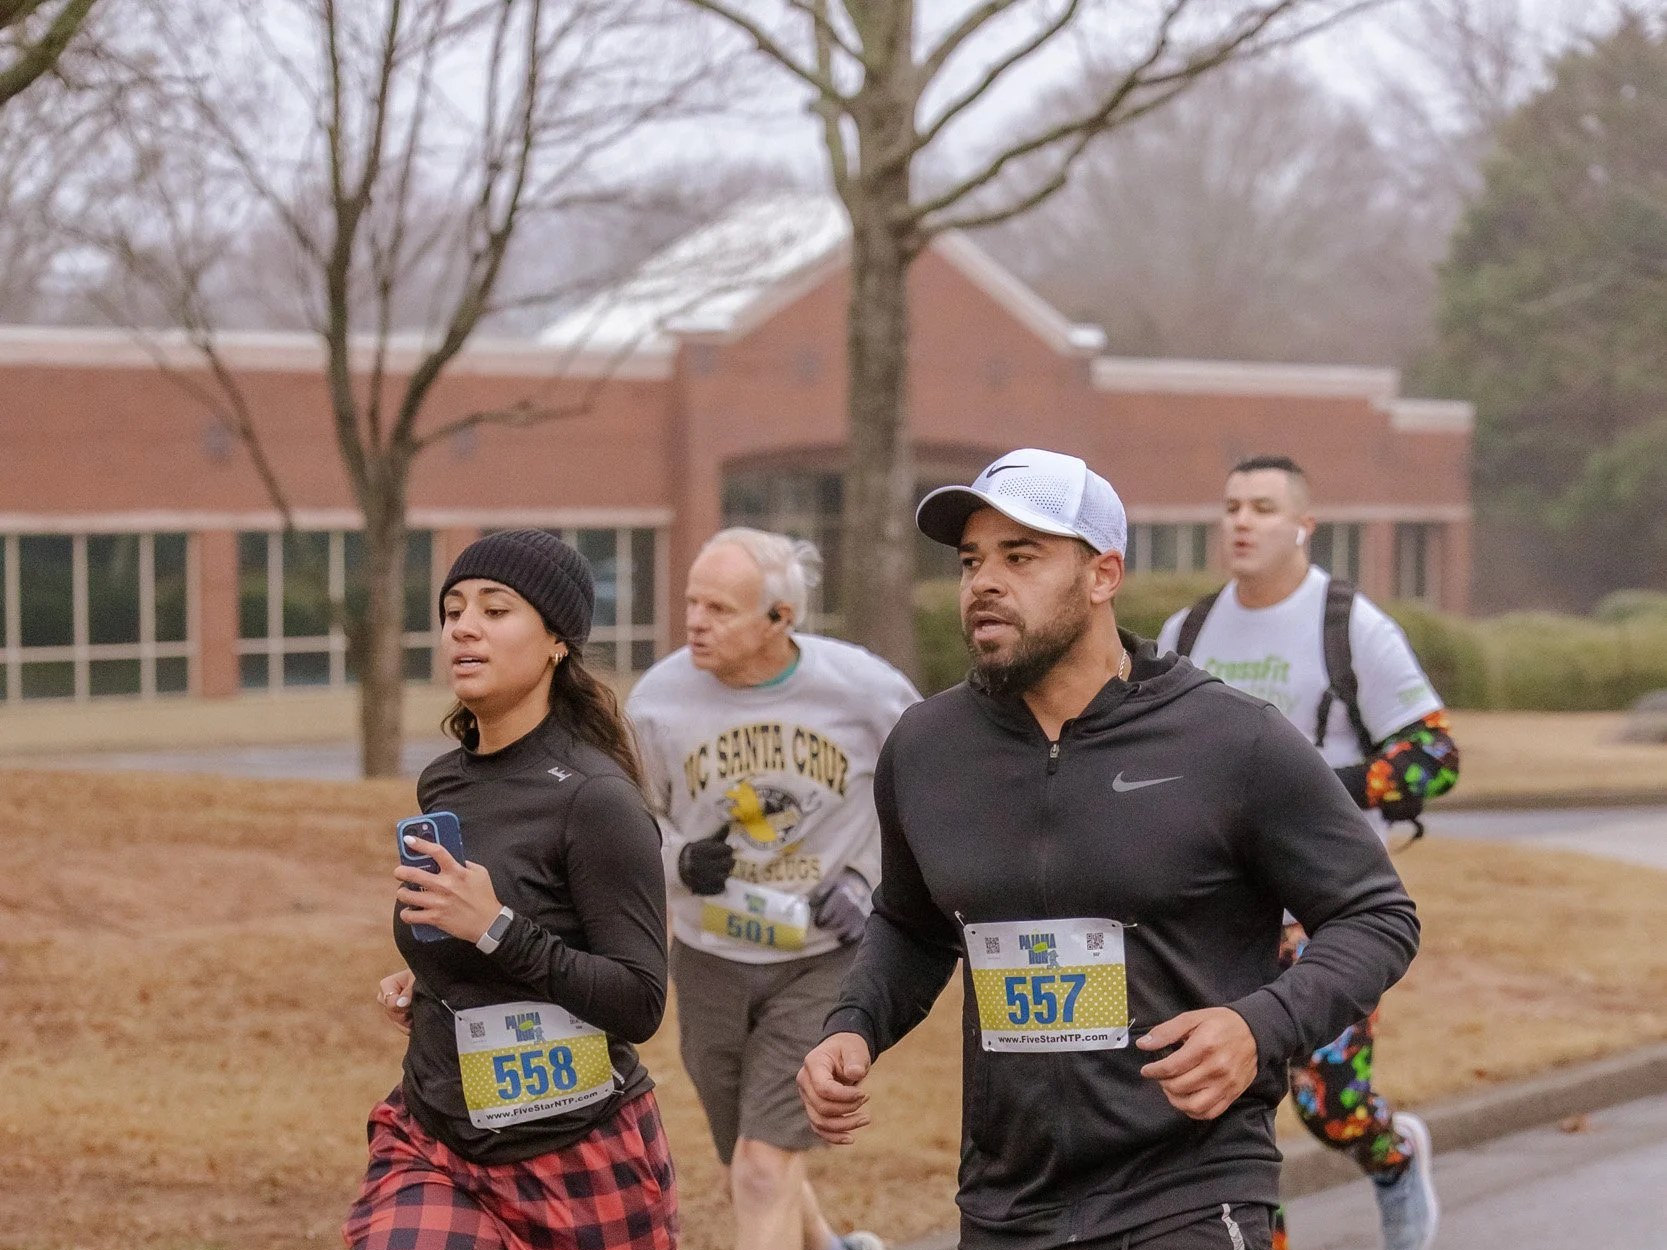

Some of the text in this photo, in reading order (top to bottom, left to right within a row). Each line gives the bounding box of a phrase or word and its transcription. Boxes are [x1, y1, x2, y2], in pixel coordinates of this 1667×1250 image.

[717, 722, 786, 779] SANTA
[727, 912, 776, 946] 501
[1004, 973, 1086, 1025] 557
[998, 1033, 1108, 1044] www.FiveStarNTP.com
[492, 1045, 578, 1100] 558
[486, 1090, 598, 1121] www.FiveStarNTP.com
